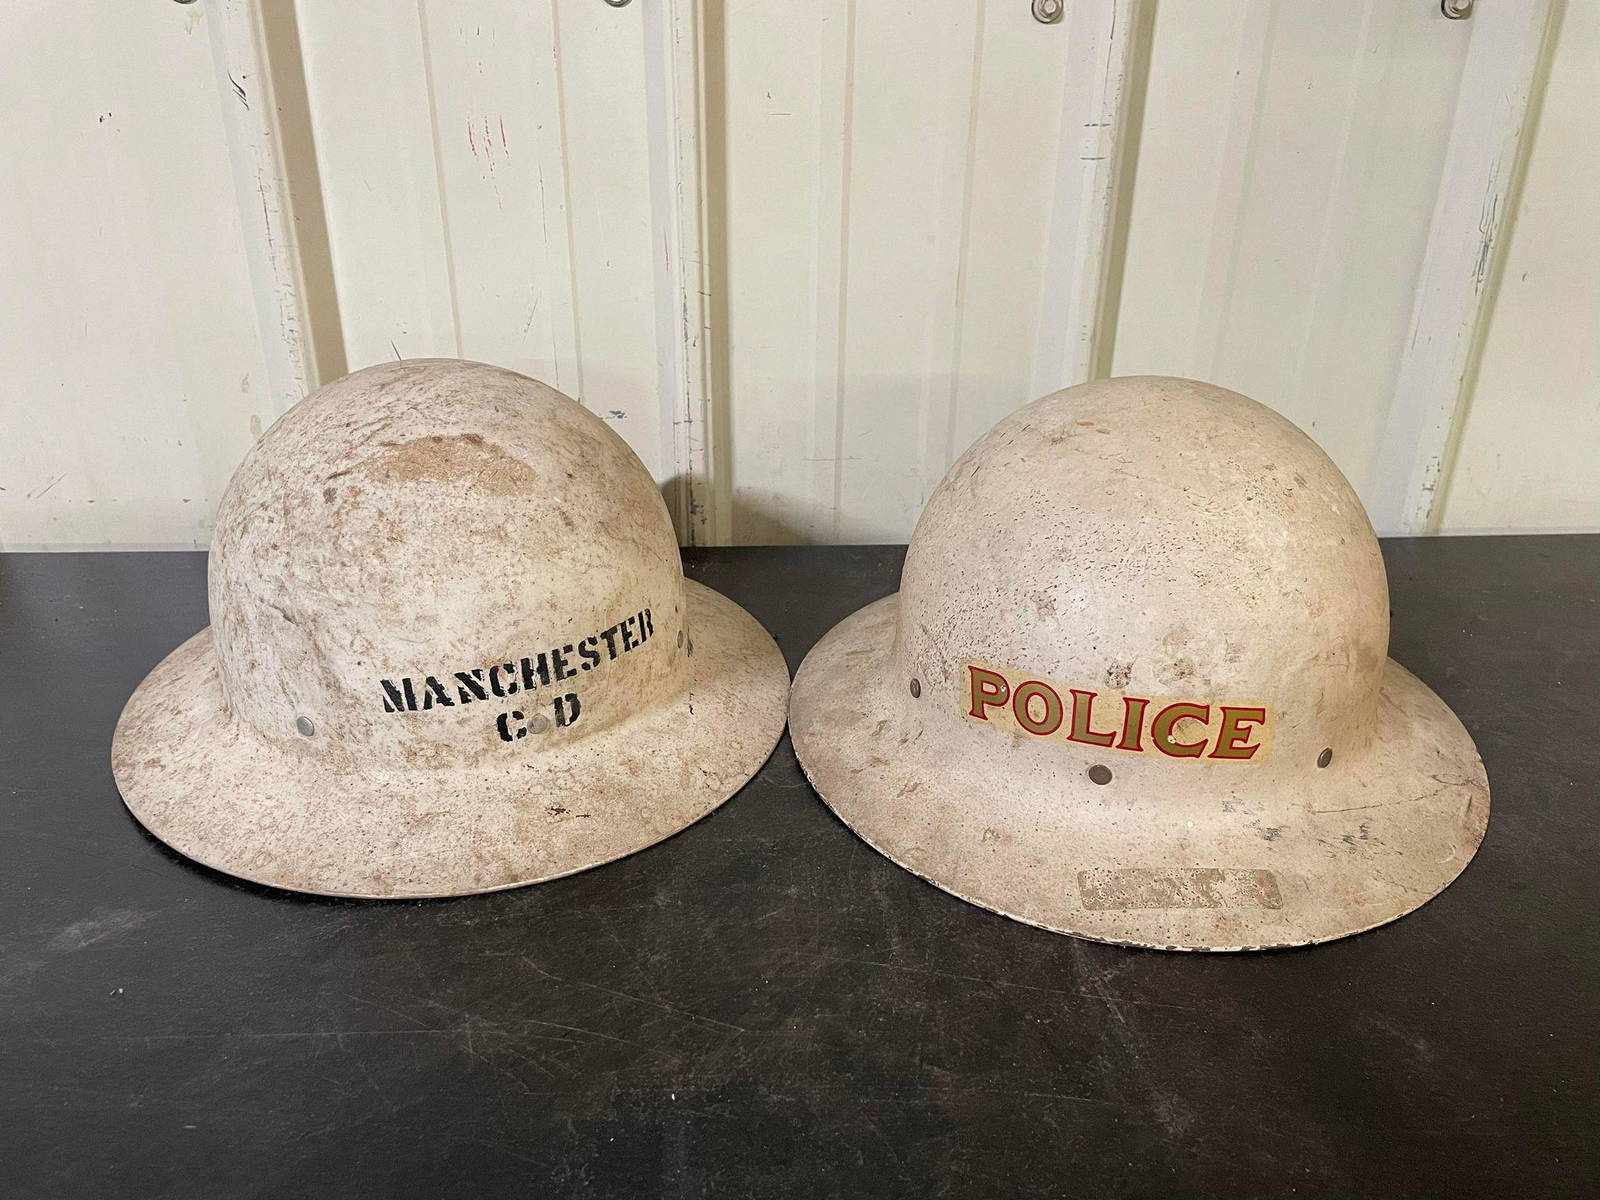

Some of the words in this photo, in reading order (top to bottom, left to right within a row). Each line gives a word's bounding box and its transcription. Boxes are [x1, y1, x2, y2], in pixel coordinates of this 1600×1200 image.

[380, 608, 654, 713] MANCHESTER
[496, 710, 528, 742] C
[554, 693, 582, 728] D
[967, 665, 1266, 760] POLICE
